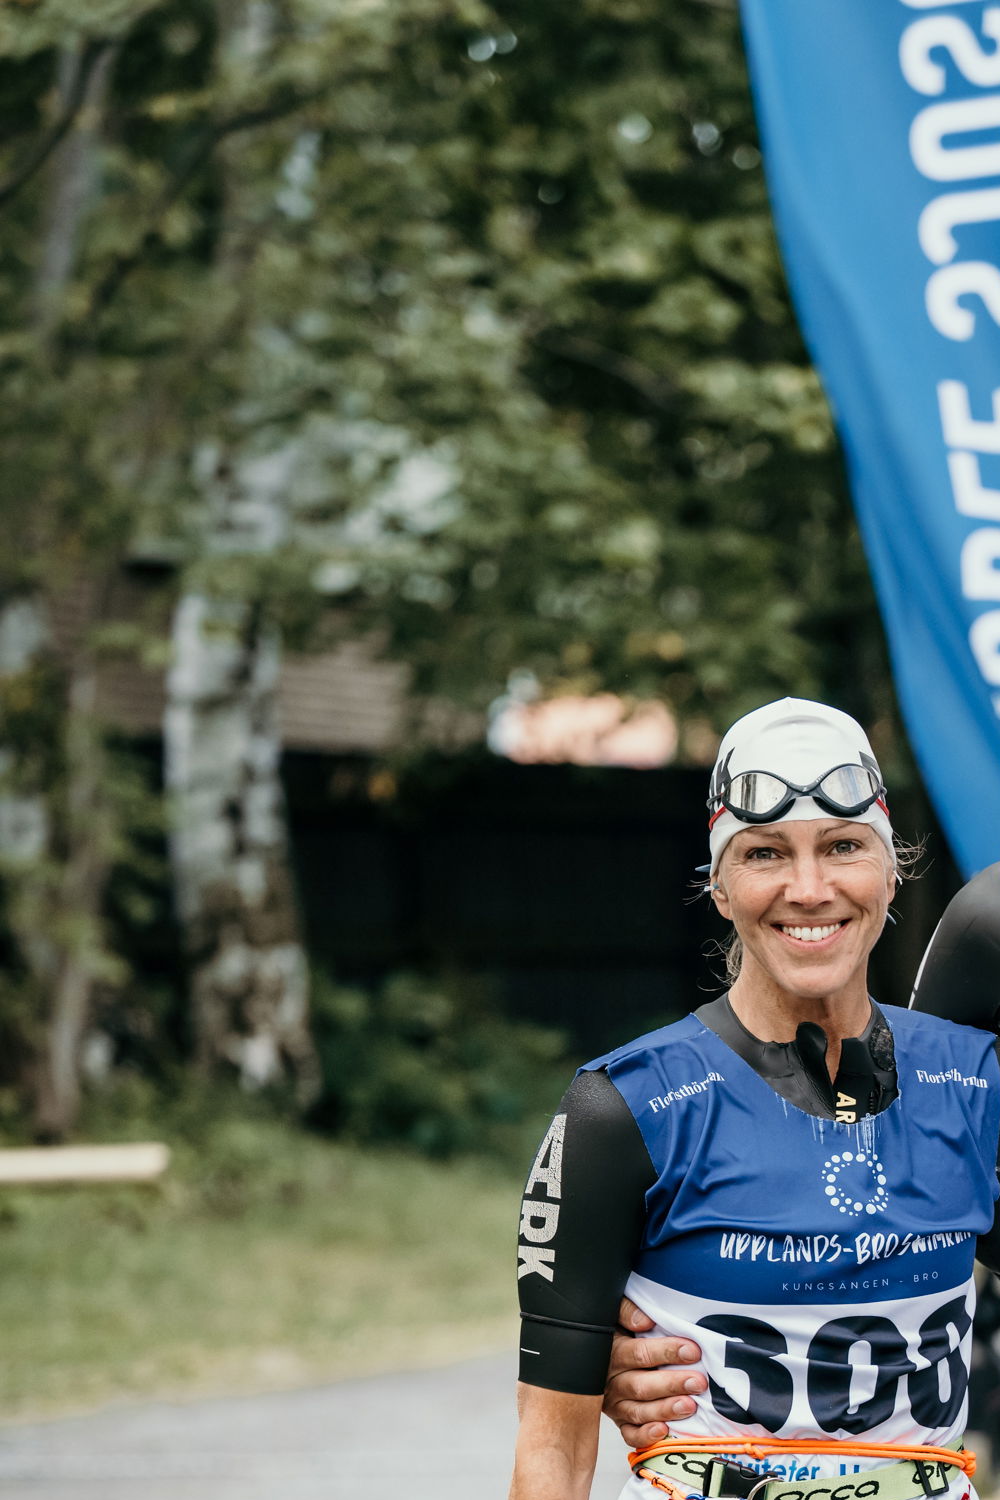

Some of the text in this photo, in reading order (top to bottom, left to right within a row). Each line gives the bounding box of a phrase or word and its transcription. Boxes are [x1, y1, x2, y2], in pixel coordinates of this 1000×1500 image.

[648, 1071, 726, 1113] Floristhöran
[517, 1113, 568, 1283] ARK
[781, 1278, 890, 1292] KUNGSÄNGEN
[912, 1270, 940, 1284] BRO
[694, 1294, 973, 1435] 308
